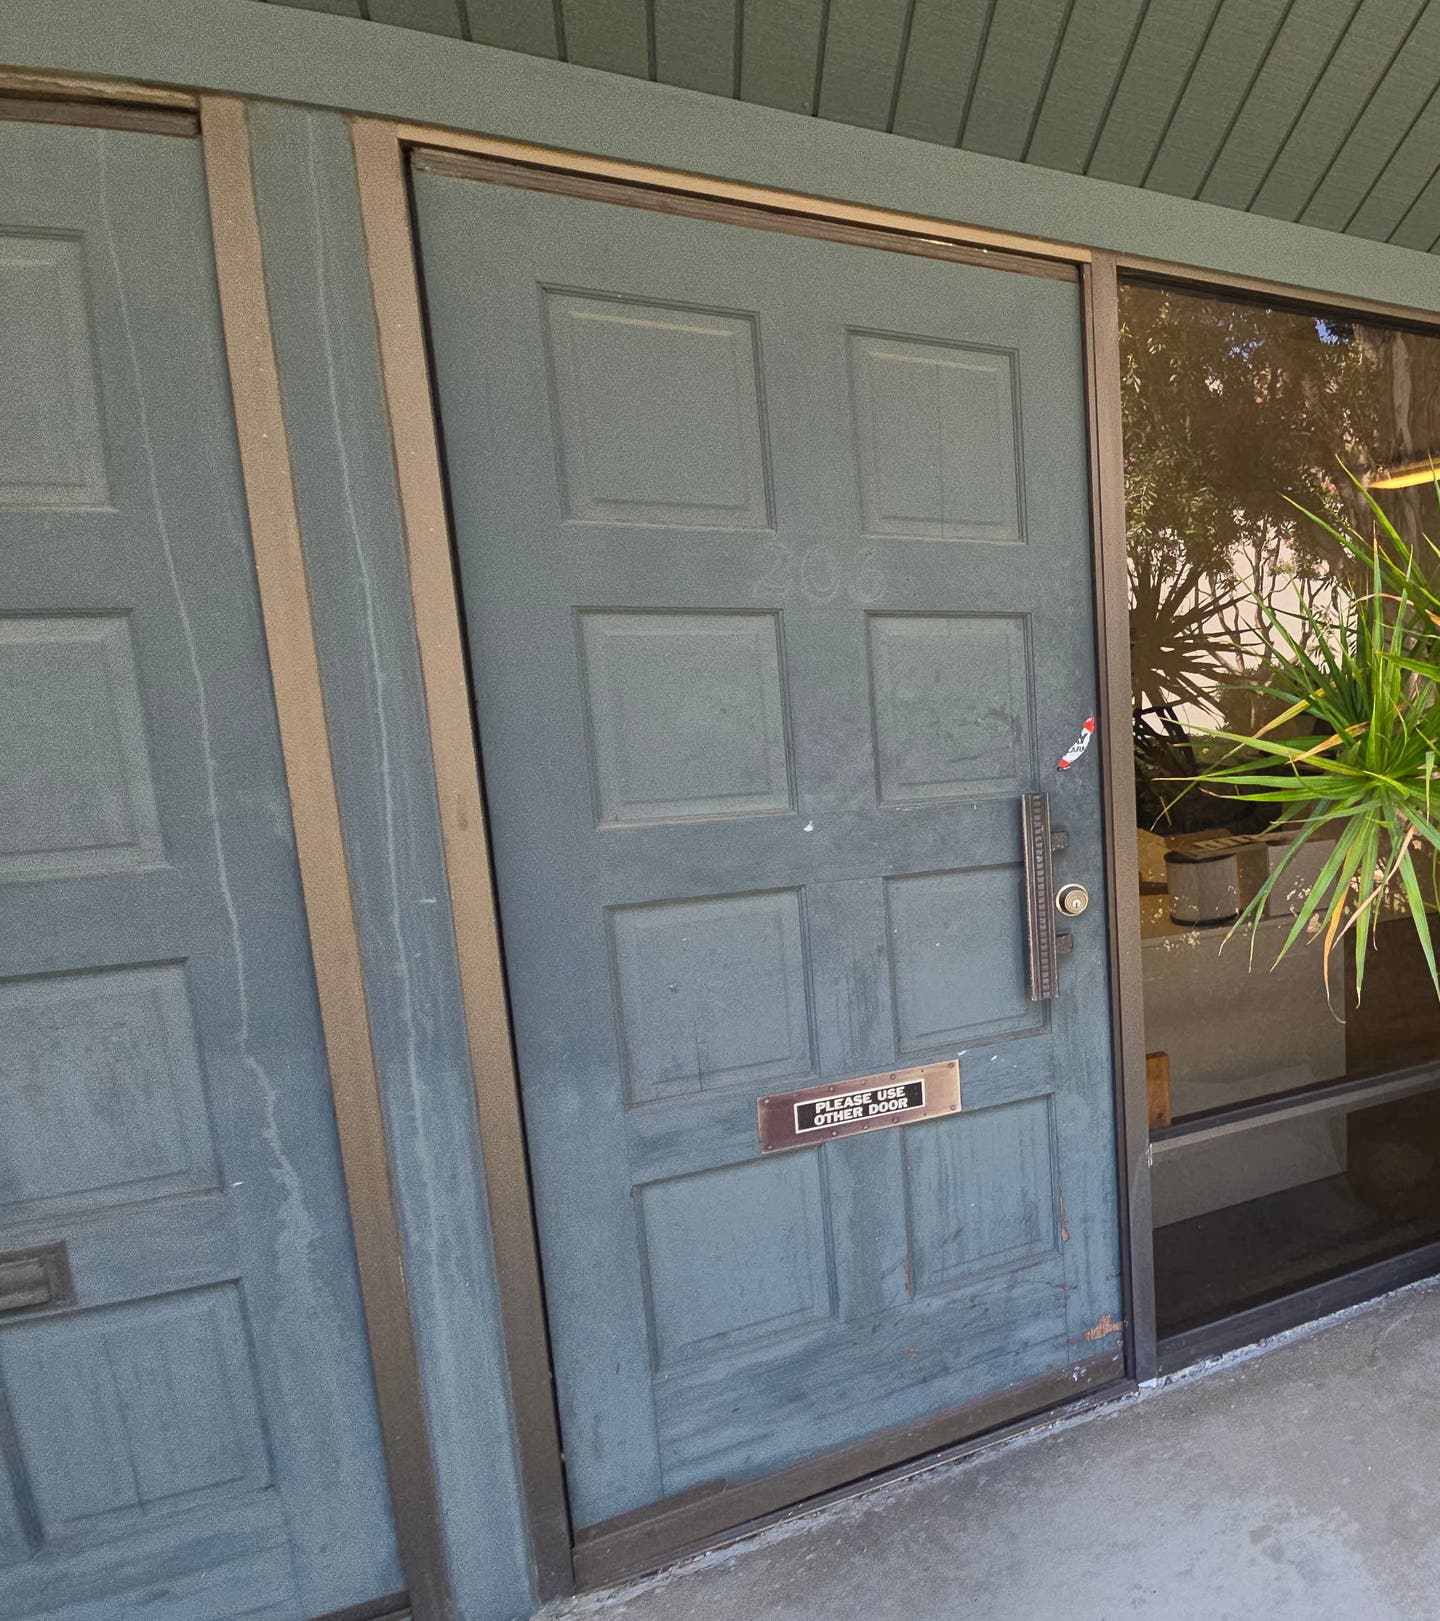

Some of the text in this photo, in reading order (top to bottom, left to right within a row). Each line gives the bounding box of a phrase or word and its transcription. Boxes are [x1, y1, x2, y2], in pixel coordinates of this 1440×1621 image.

[814, 1097, 908, 1125] OTHER DOOR
[815, 1086, 906, 1113] PLEASE USE
